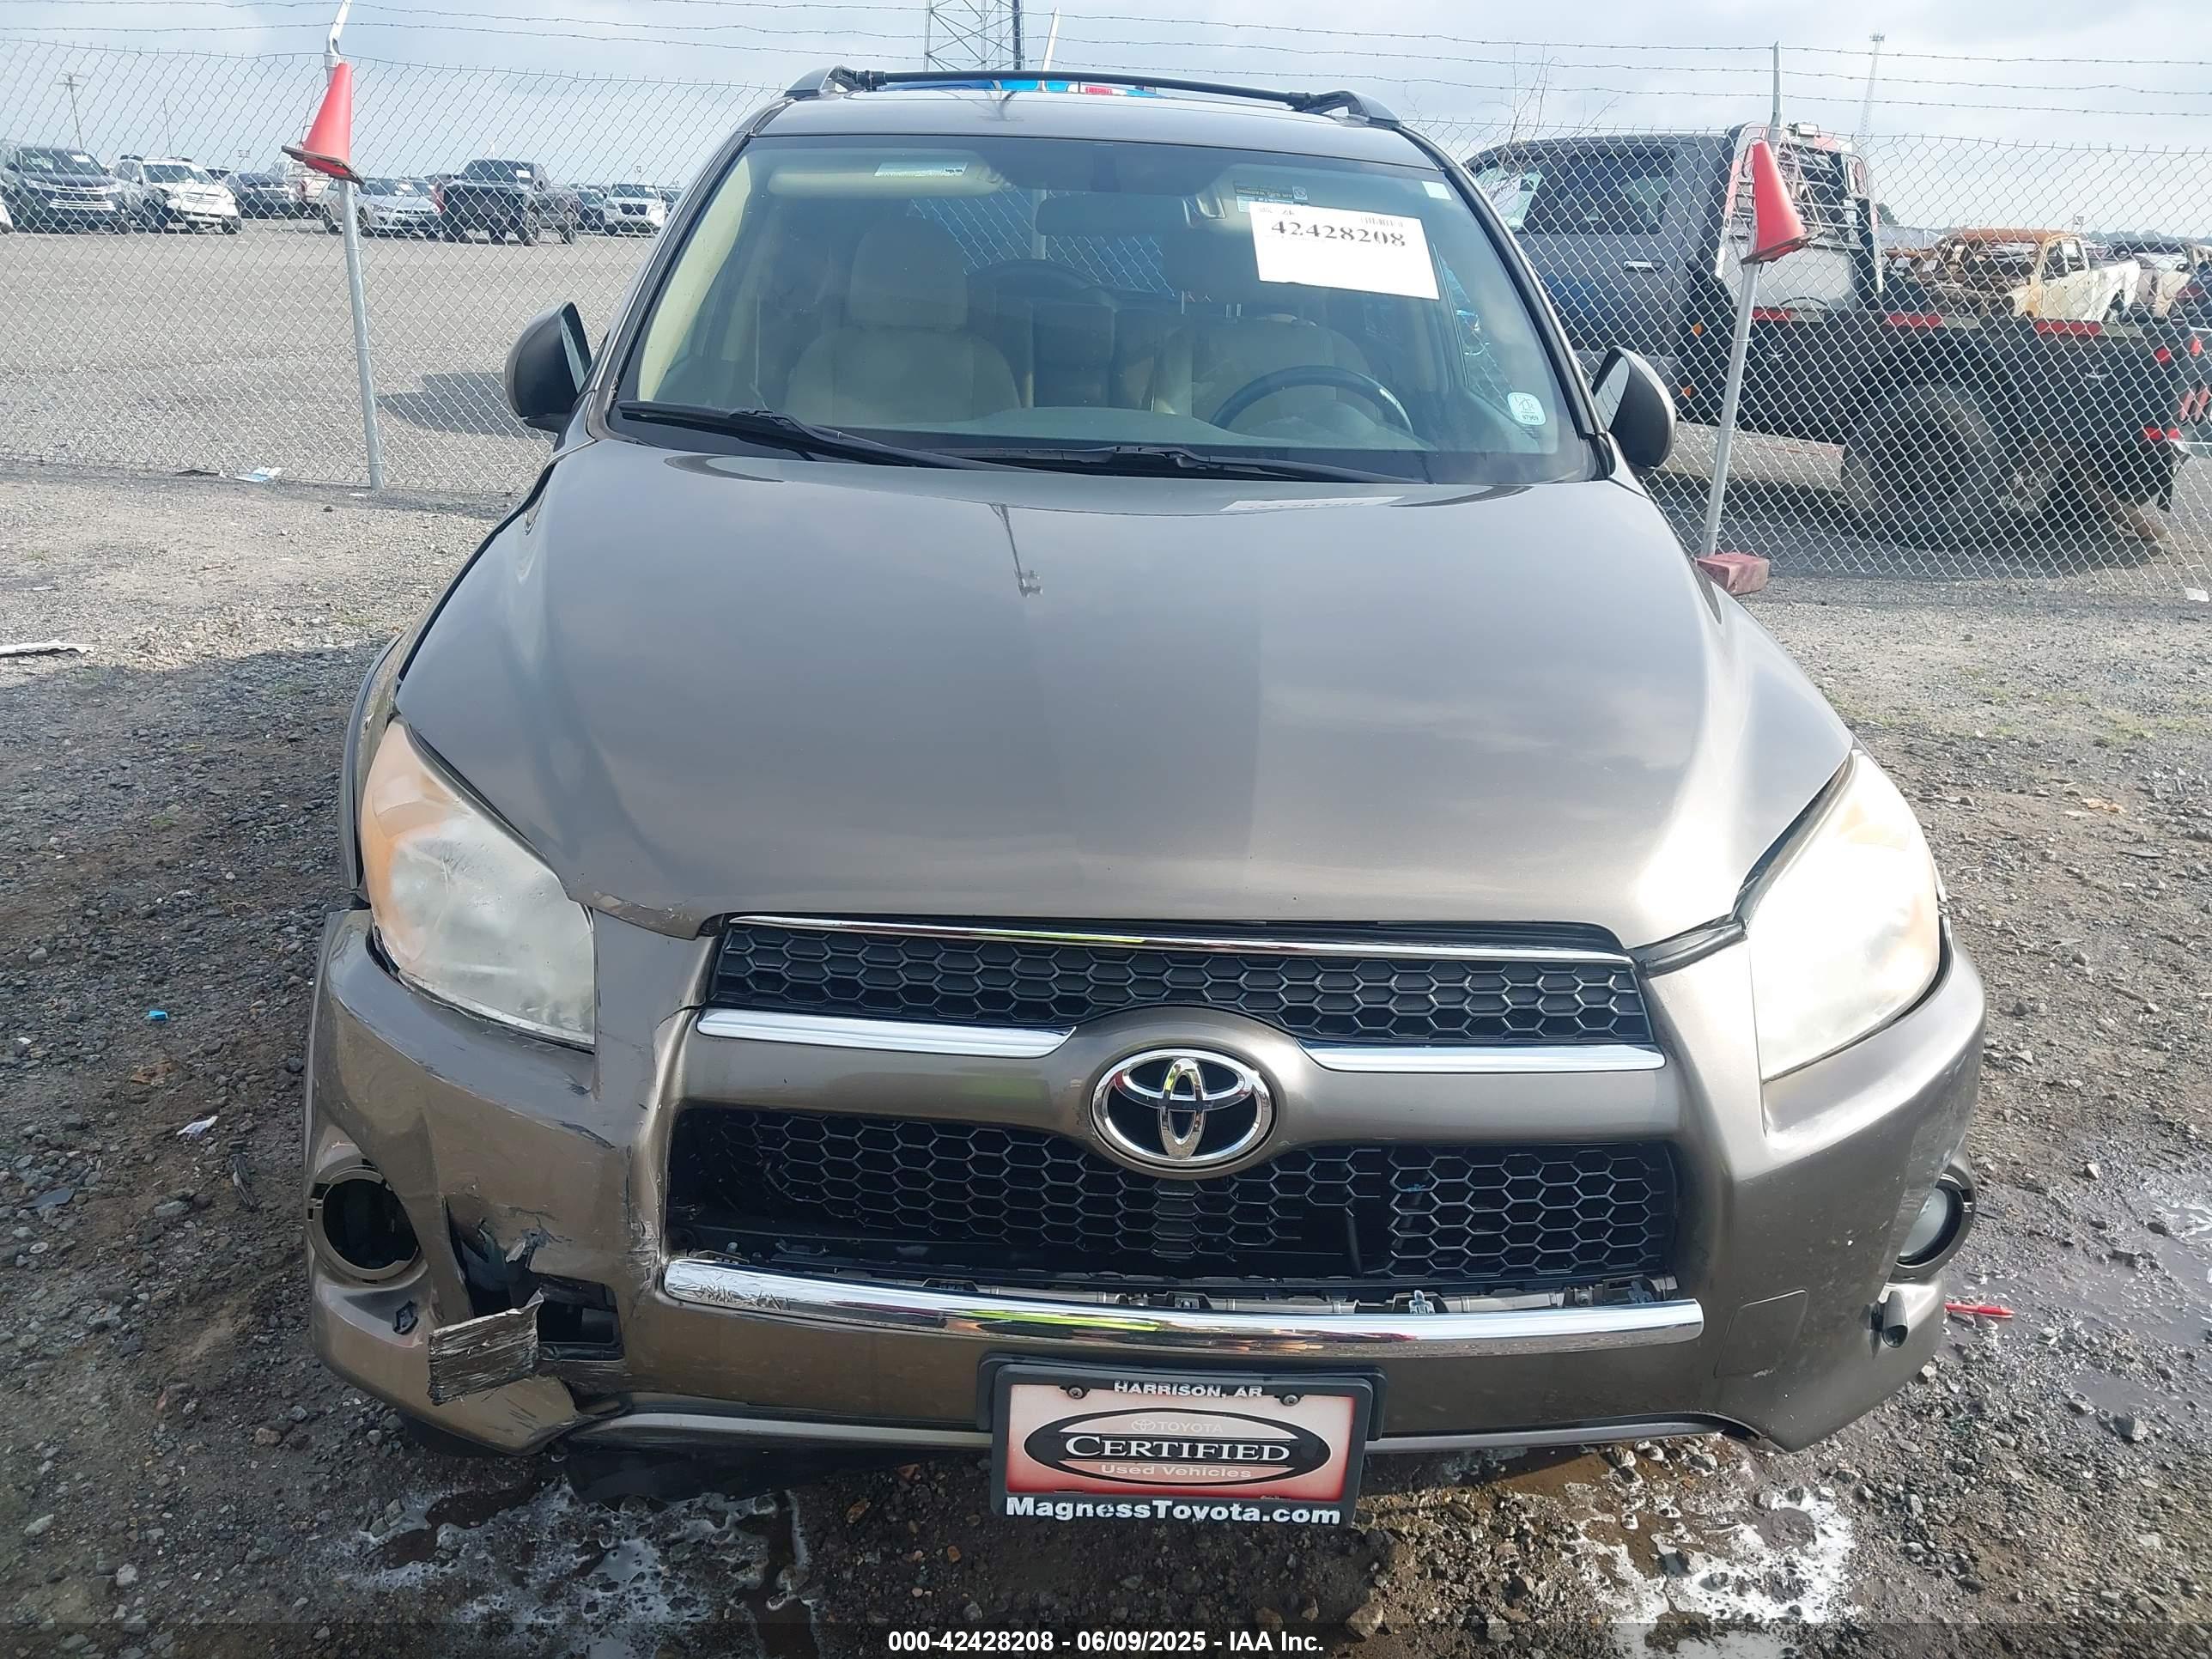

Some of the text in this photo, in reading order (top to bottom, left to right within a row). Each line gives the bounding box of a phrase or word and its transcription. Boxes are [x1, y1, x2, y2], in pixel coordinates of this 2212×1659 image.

[1271, 220, 1406, 246] 42428208
[1114, 1380, 1263, 1400] HARRISON, AR
[1159, 1421, 1224, 1433] TOYOTA
[1101, 1463, 1252, 1479] Used Vehicles
[1006, 1496, 1341, 1525] MagnessToyota.com
